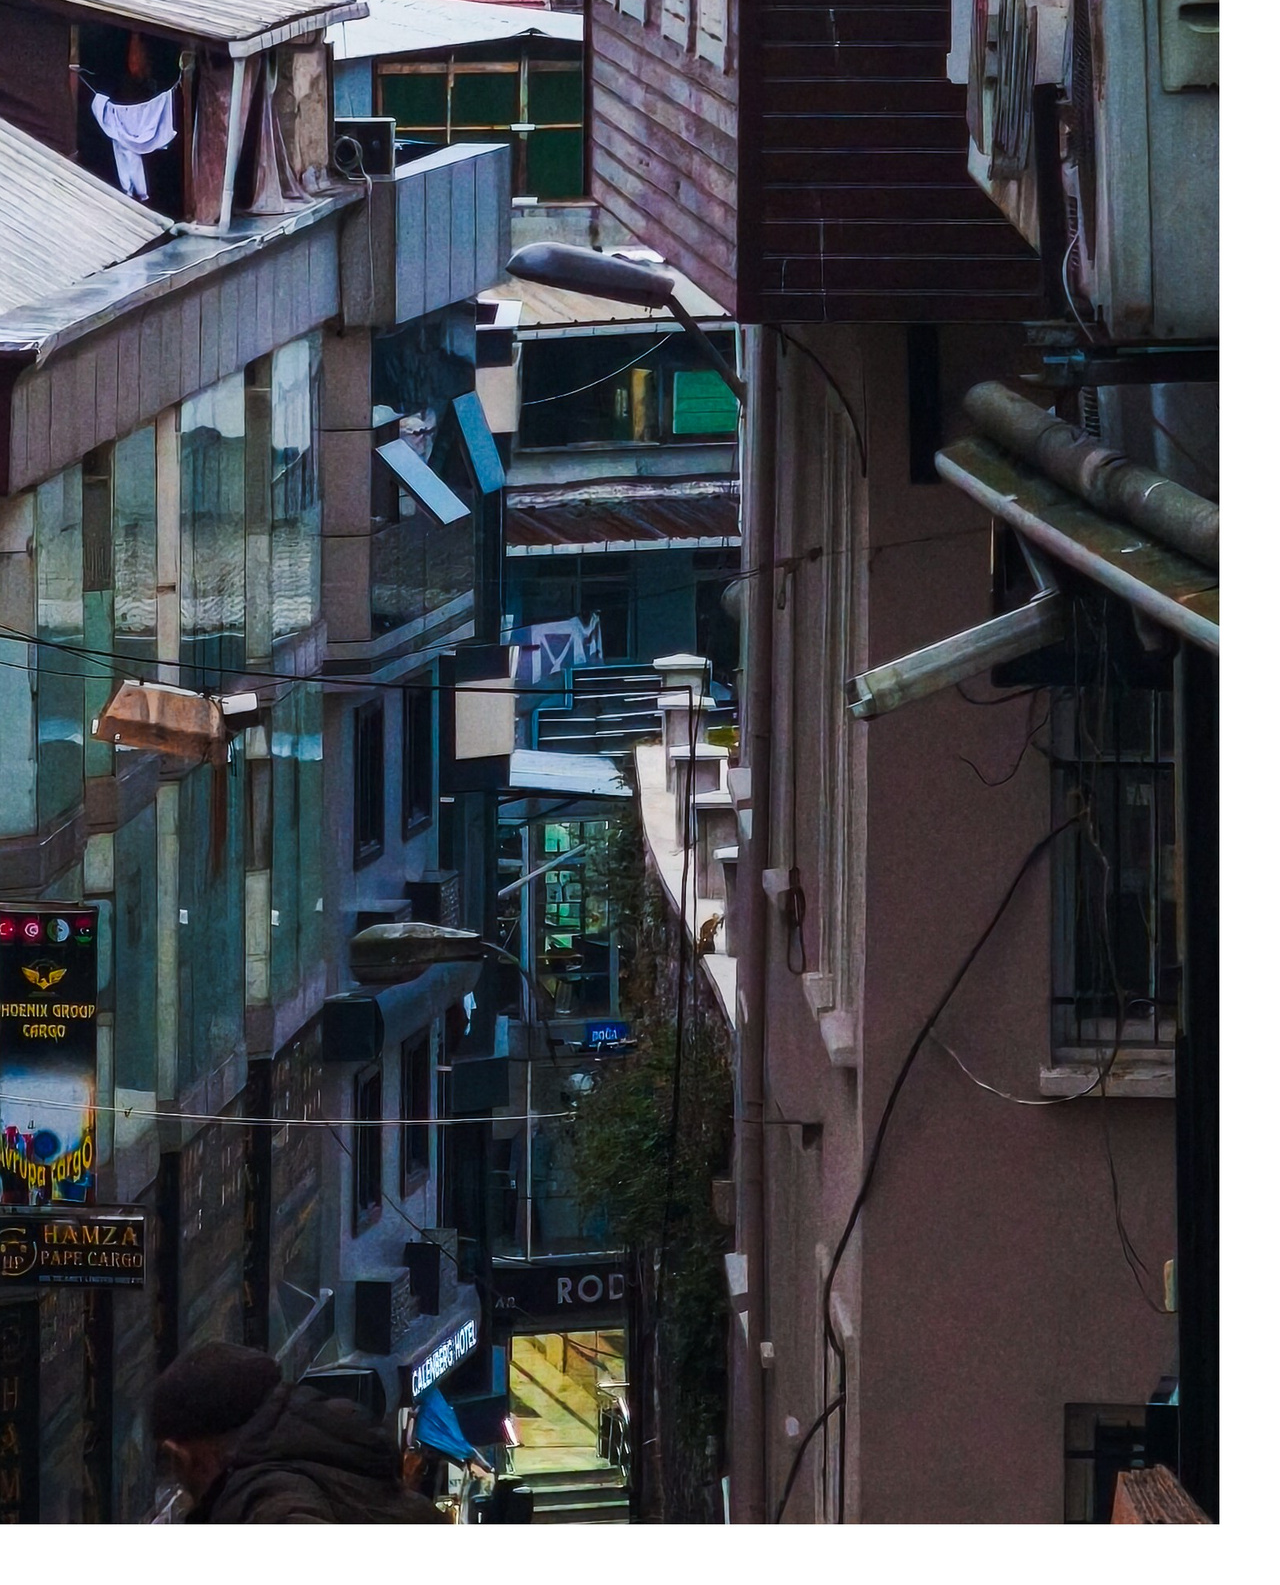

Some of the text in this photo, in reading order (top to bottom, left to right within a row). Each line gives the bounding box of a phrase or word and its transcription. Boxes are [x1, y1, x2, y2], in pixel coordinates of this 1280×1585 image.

[0, 1003, 96, 1019] HOENIX GROUP
[23, 1024, 66, 1042] CARGO
[43, 1223, 138, 1246] HAMZA
[87, 1251, 143, 1269] CARGO
[454, 1319, 477, 1362] HOTEL
